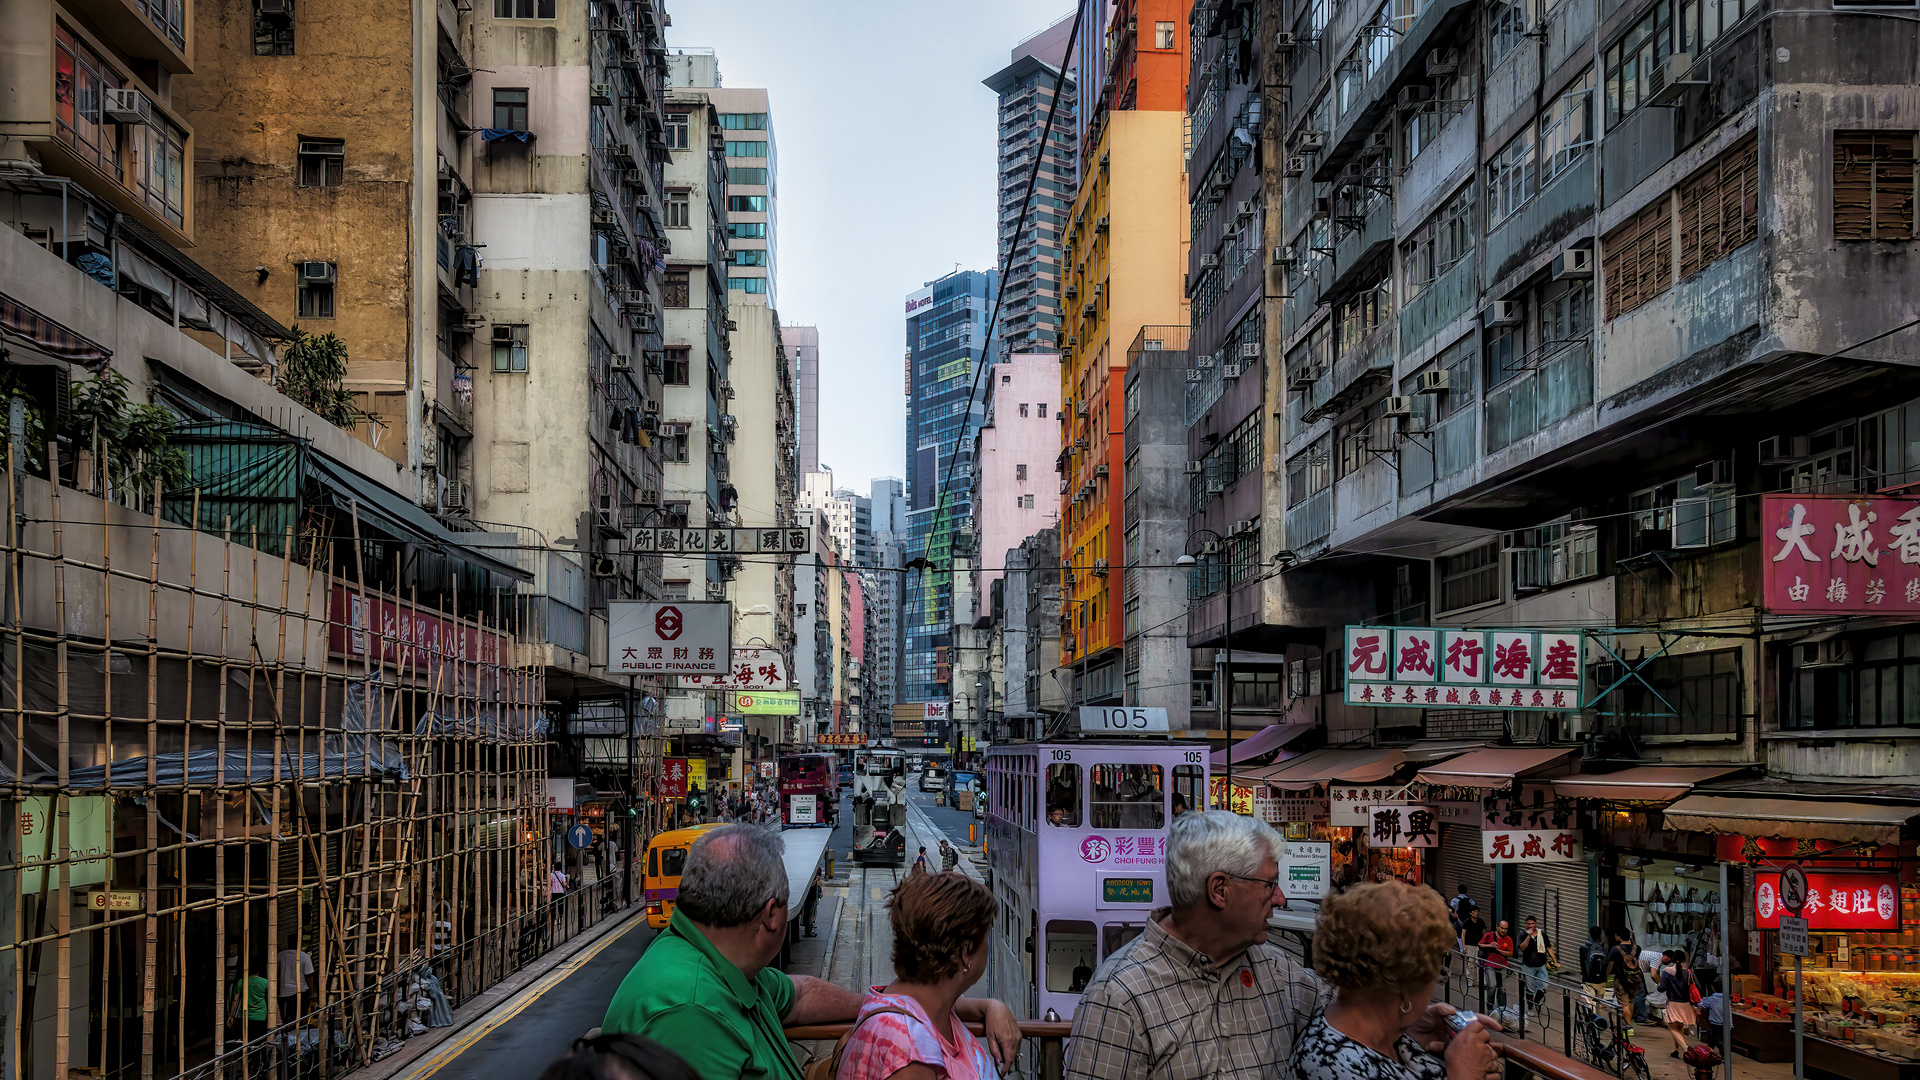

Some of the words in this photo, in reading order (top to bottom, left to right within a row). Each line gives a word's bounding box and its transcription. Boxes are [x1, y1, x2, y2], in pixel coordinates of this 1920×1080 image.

[905, 299, 917, 313] ibis
[918, 296, 932, 308] HOTEL
[622, 647, 714, 660] 大眾財務
[1349, 635, 1579, 680] 元成行海產
[665, 662, 716, 670] FINANCE
[682, 662, 782, 685] 海味
[1103, 708, 1148, 729] 105
[1051, 750, 1072, 761] 105
[1183, 752, 1203, 763] 105
[1373, 808, 1436, 846] 聯興
